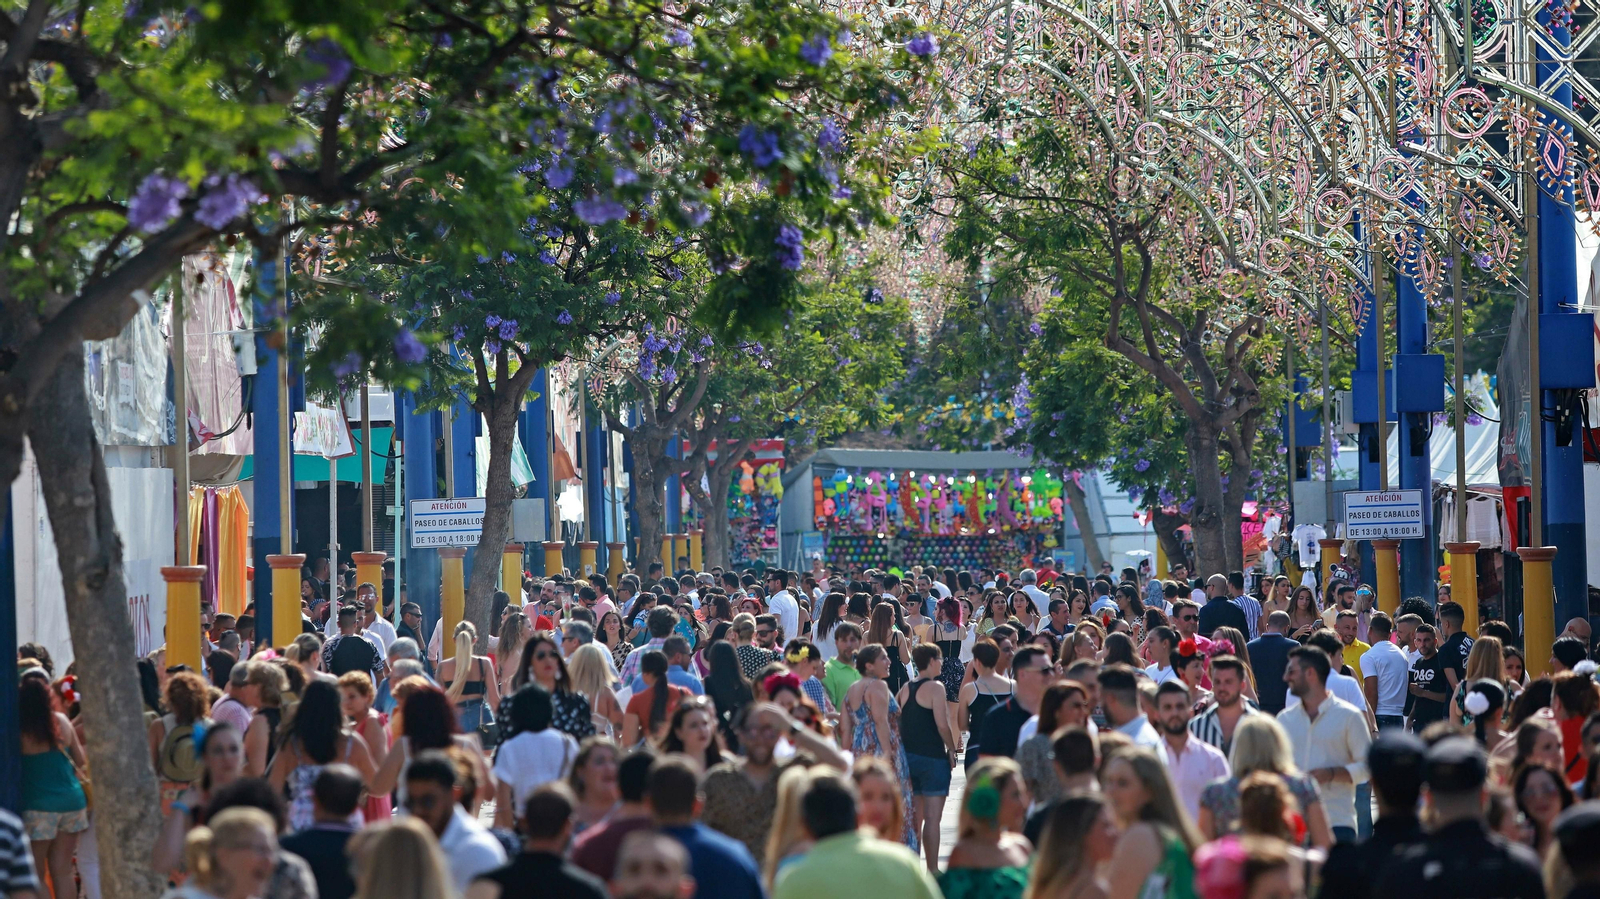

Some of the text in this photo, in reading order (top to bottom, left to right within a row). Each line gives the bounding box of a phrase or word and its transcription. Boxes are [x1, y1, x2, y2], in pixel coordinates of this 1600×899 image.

[1366, 494, 1402, 502] ATENCIÓN
[432, 502, 466, 510] ATENCIÓN
[1348, 512, 1370, 520] PASEO
[1384, 510, 1420, 518] CABALLOS
[438, 518, 447, 526] DE
[448, 518, 484, 526] CABALLOS
[1414, 669, 1434, 680] D&G
